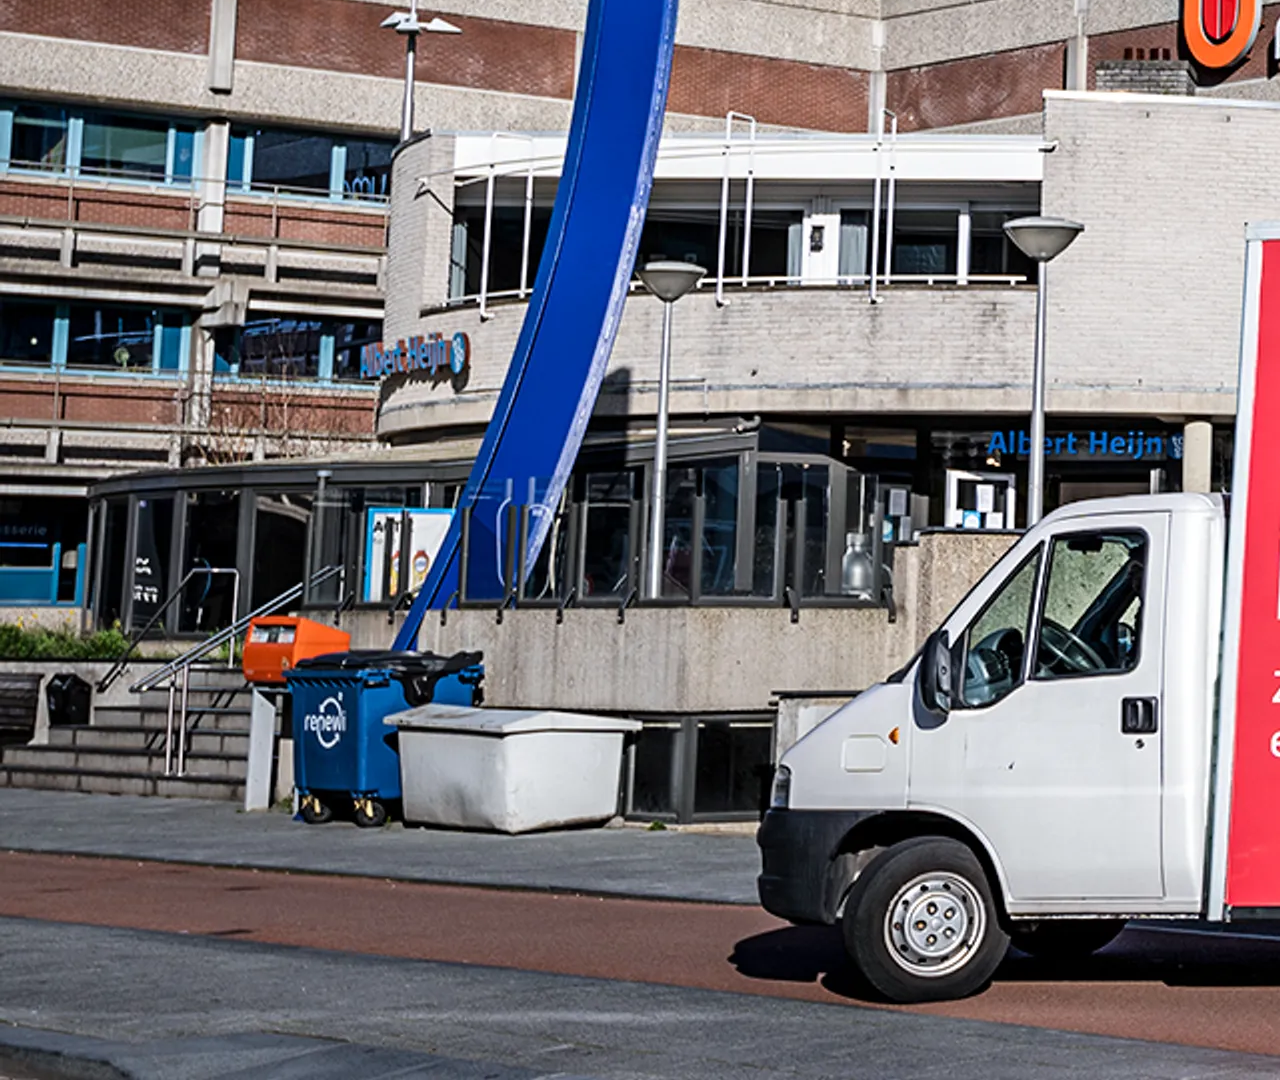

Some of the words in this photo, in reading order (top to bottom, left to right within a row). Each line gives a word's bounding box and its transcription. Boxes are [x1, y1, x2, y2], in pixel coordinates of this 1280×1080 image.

[360, 339, 407, 380] Albert
[407, 332, 451, 375] Heijn
[987, 430, 1078, 456] Albert
[1089, 431, 1162, 460] Heijn
[303, 710, 347, 732] renewi
